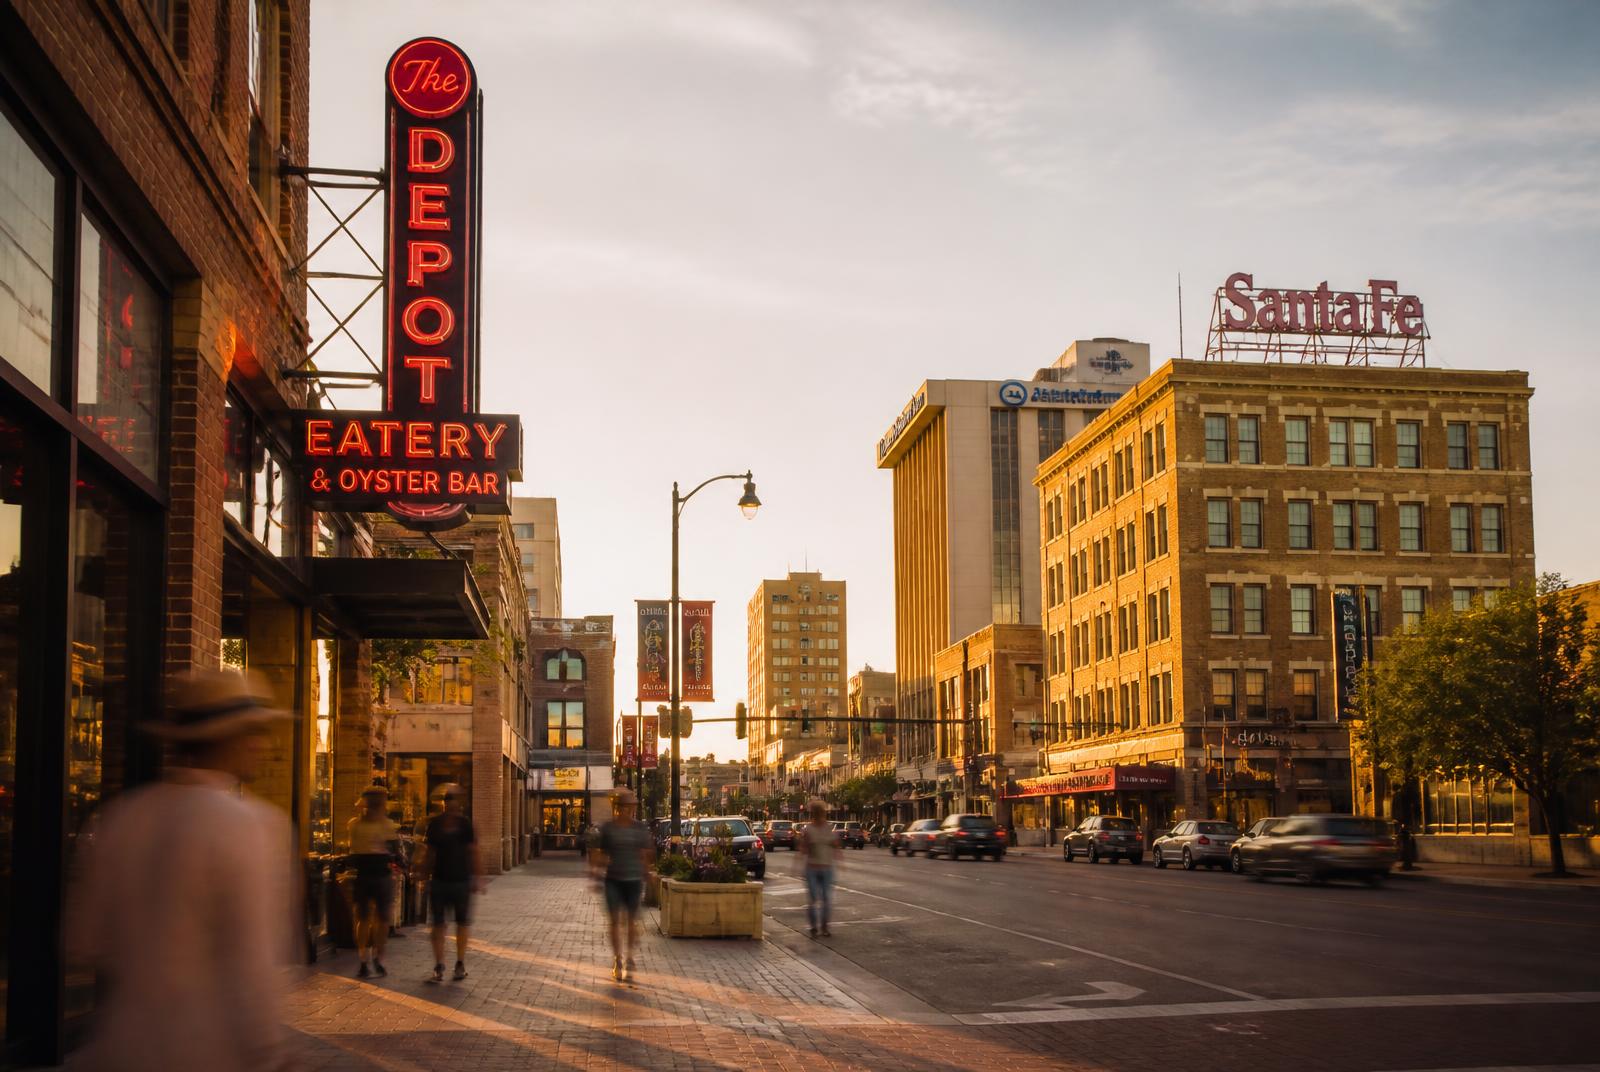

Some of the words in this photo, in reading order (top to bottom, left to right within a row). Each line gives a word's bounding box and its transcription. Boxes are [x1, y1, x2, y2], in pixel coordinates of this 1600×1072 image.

[403, 57, 459, 93] The
[402, 127, 455, 403] DEPOT
[1225, 272, 1364, 332] Santa
[1368, 279, 1424, 335] Fe
[305, 419, 507, 460] EATERY
[311, 468, 331, 493] &
[339, 469, 440, 494] OYSTER
[448, 471, 499, 495] BAR
